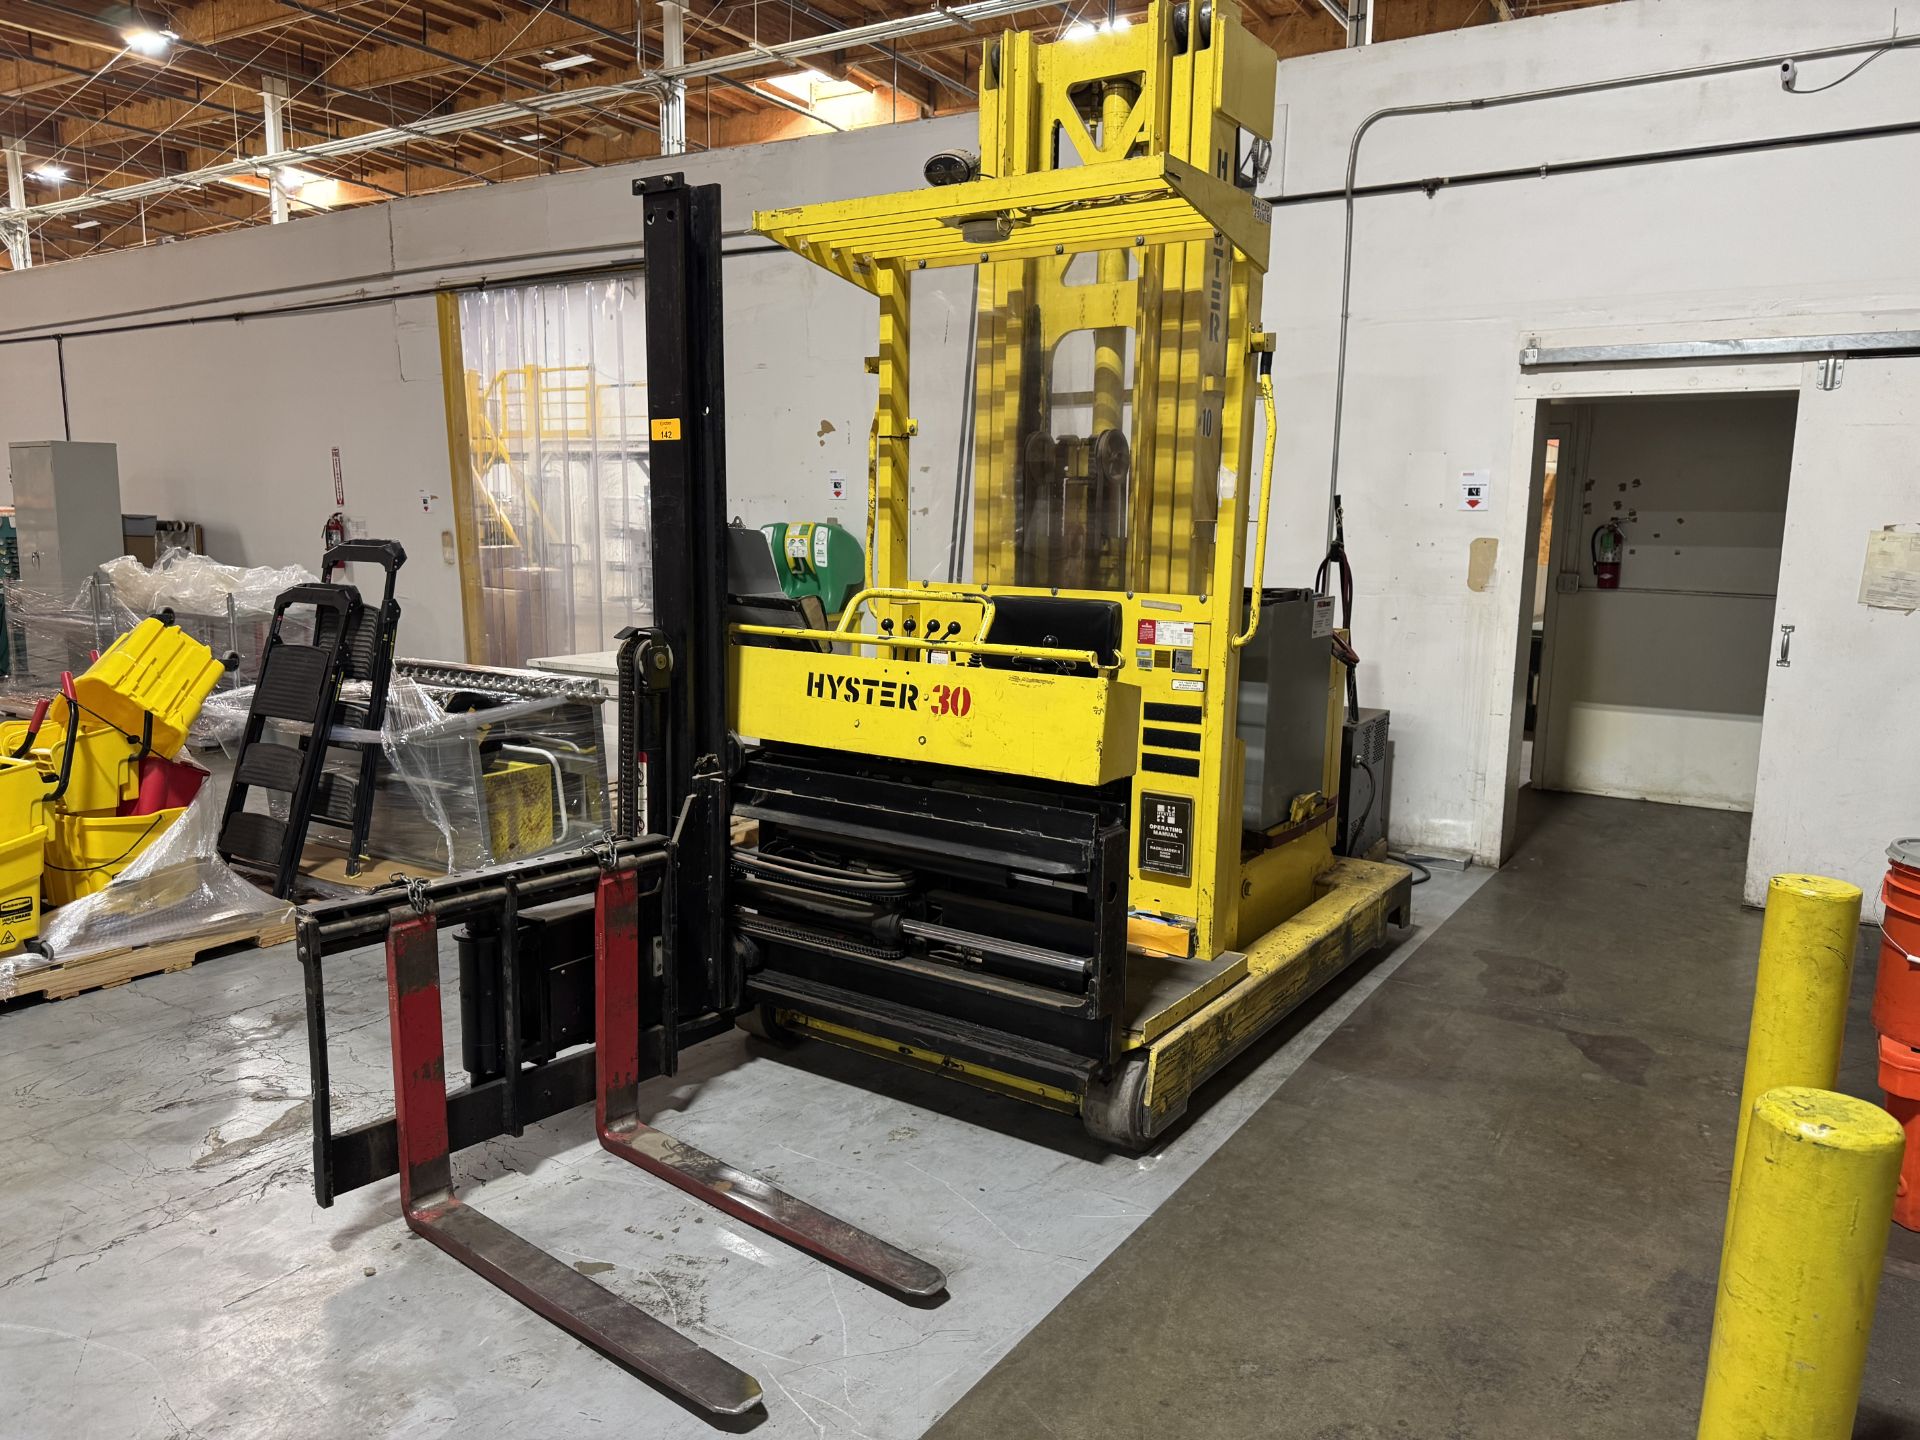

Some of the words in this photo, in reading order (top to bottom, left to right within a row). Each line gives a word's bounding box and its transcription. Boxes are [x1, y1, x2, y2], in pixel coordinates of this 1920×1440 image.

[661, 431, 673, 439] 142
[806, 671, 919, 711] HYSTER
[930, 684, 972, 718] 30
[1149, 823, 1183, 834] OPERATING
[1152, 829, 1178, 839] MANUAL
